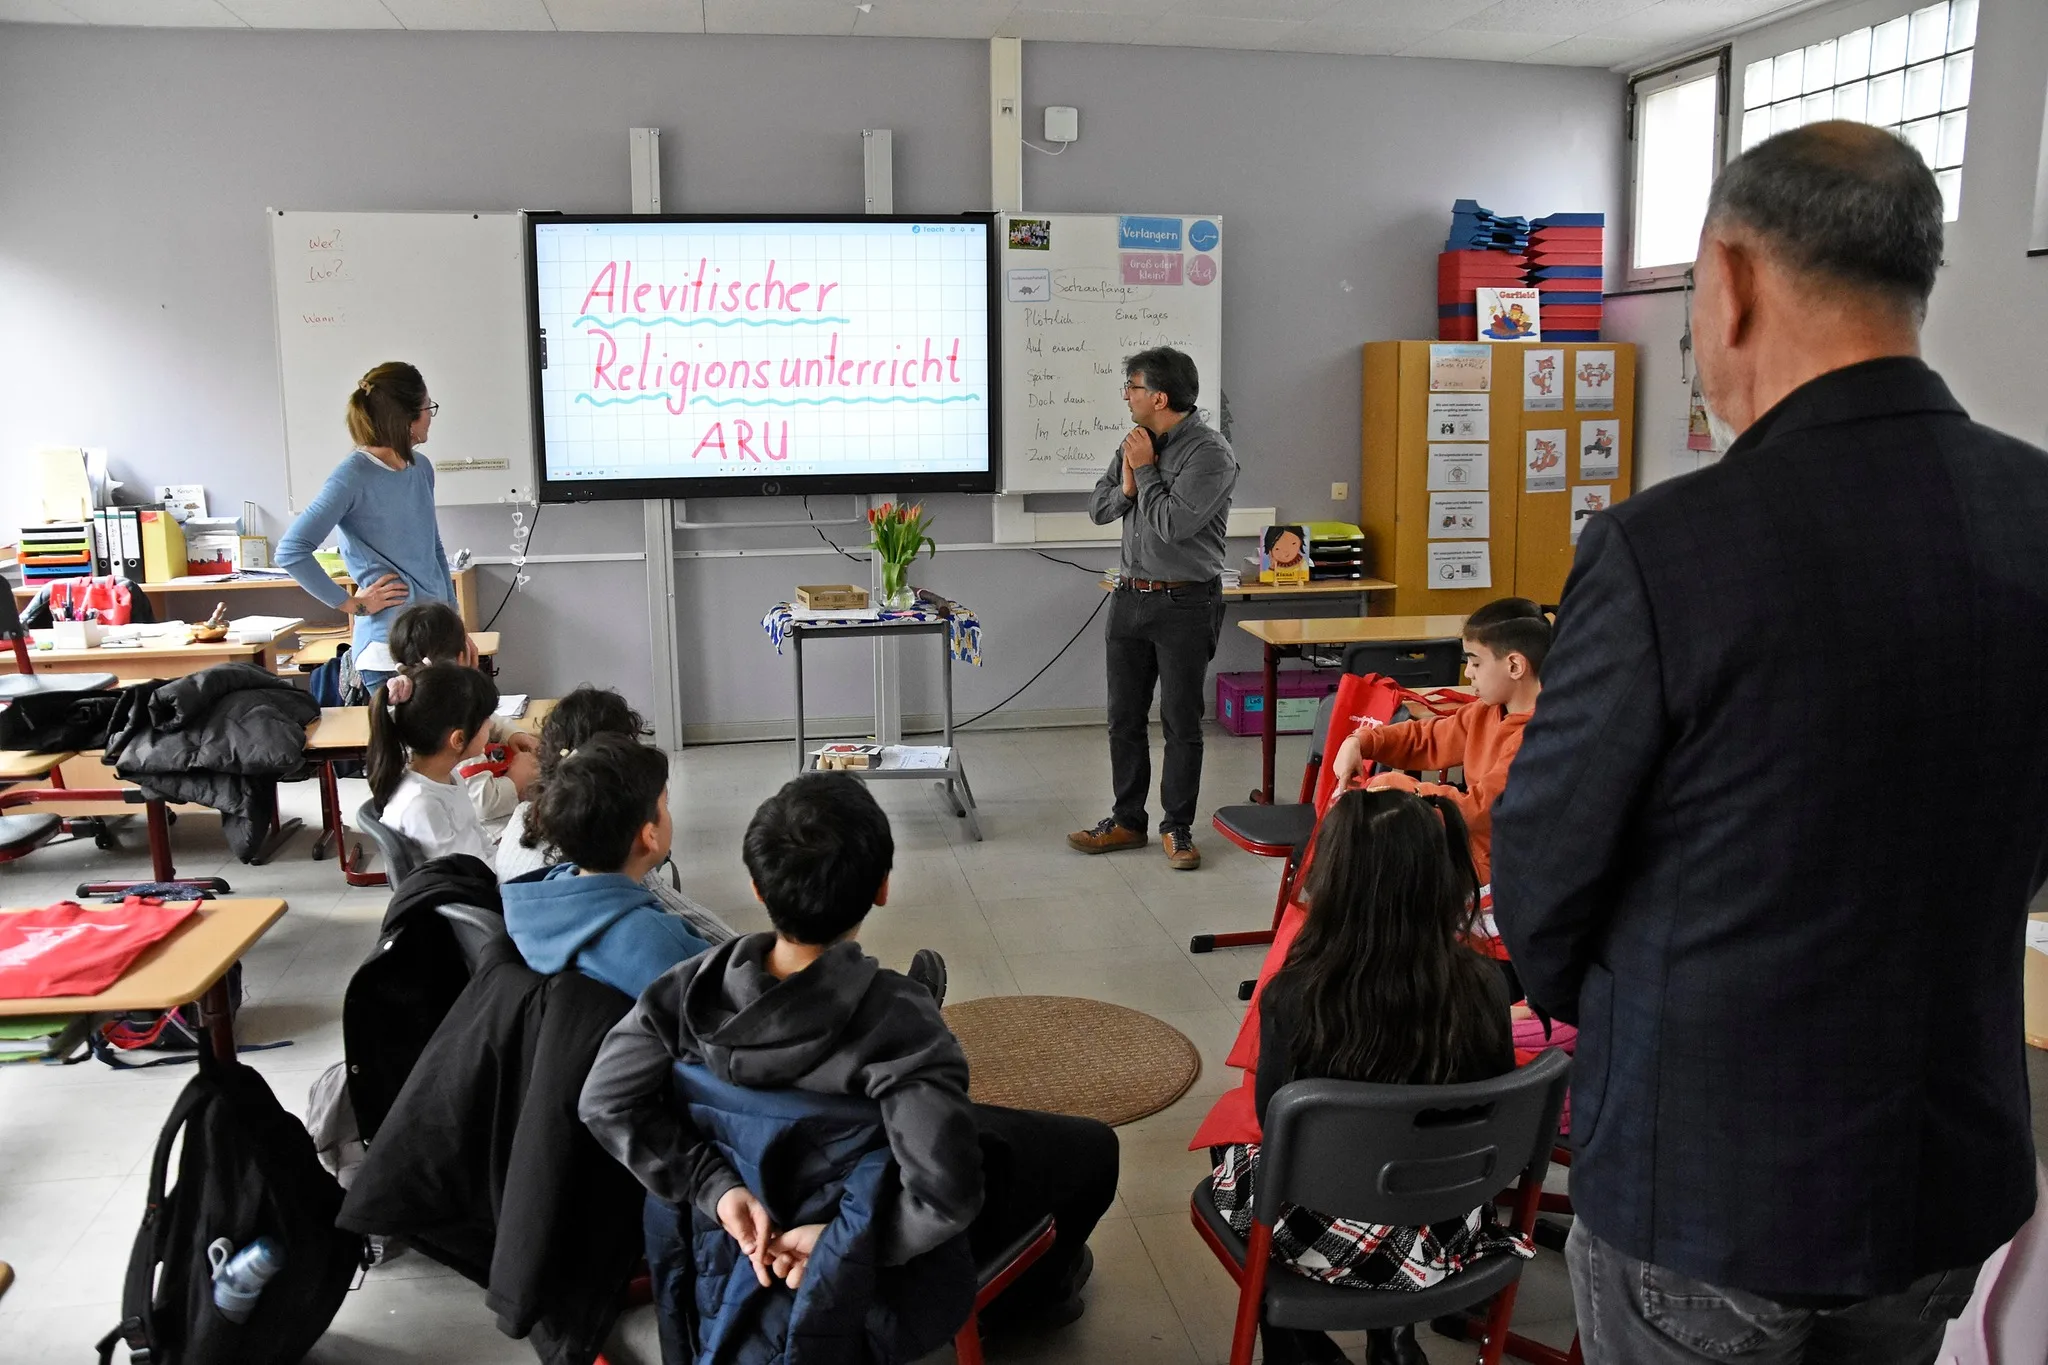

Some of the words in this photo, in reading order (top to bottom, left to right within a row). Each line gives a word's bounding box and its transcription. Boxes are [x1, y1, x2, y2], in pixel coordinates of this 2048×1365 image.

[1130, 259, 1153, 269] Groß
[1154, 260, 1173, 269] oder
[1139, 270, 1165, 280] klein?
[579, 257, 839, 316] Alevitischer
[1499, 290, 1536, 299] Garfield
[1115, 308, 1139, 321] Eines
[1139, 307, 1169, 327] Tages
[587, 328, 961, 415] Religionsunterricht
[1093, 362, 1113, 375] Nach
[1028, 391, 1056, 408] Doch
[691, 419, 789, 464] ARU
